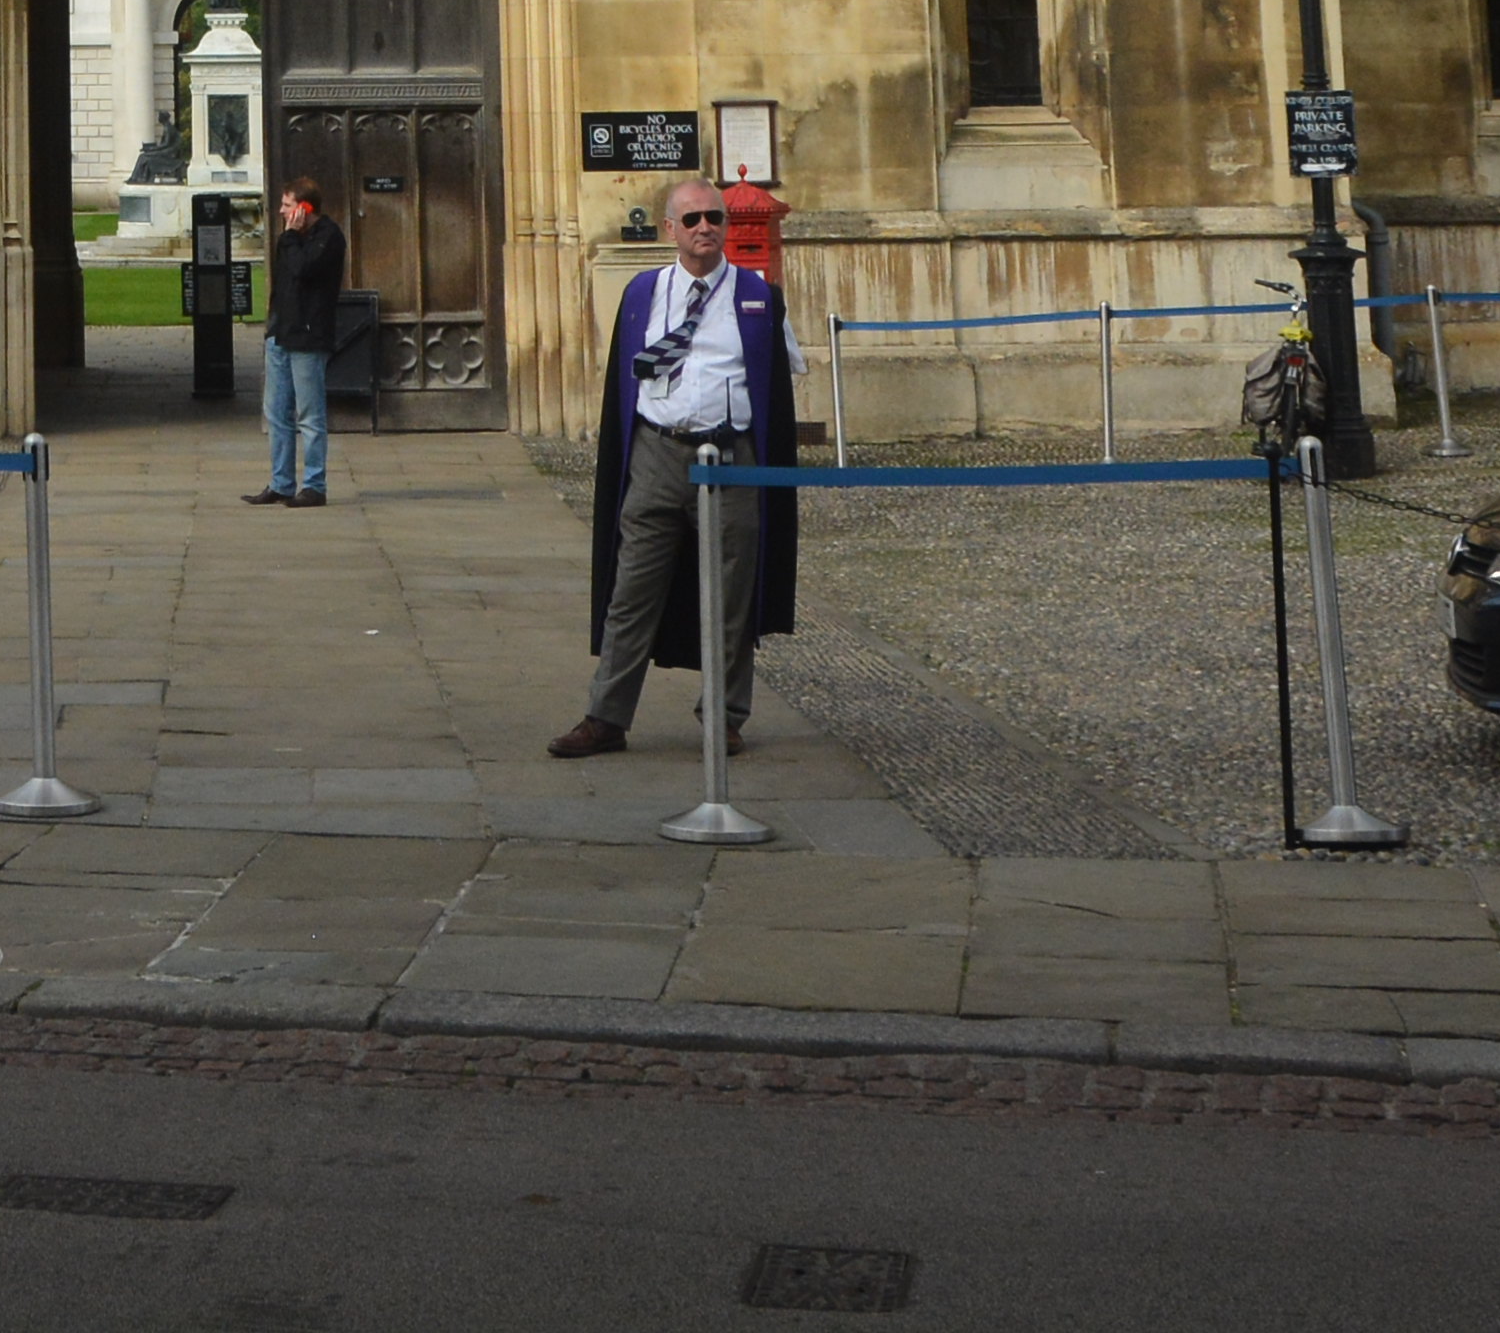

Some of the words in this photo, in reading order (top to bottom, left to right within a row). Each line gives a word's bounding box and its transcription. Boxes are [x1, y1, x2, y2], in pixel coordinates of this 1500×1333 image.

[646, 113, 667, 125] NO
[1294, 110, 1344, 121] PRIVATE
[665, 124, 693, 134] DOGS
[1293, 122, 1347, 134] PARKING
[637, 133, 676, 143] RADIOS
[626, 142, 643, 152] OR
[644, 142, 683, 151] PICNICS
[631, 151, 682, 161] ALLOWED
